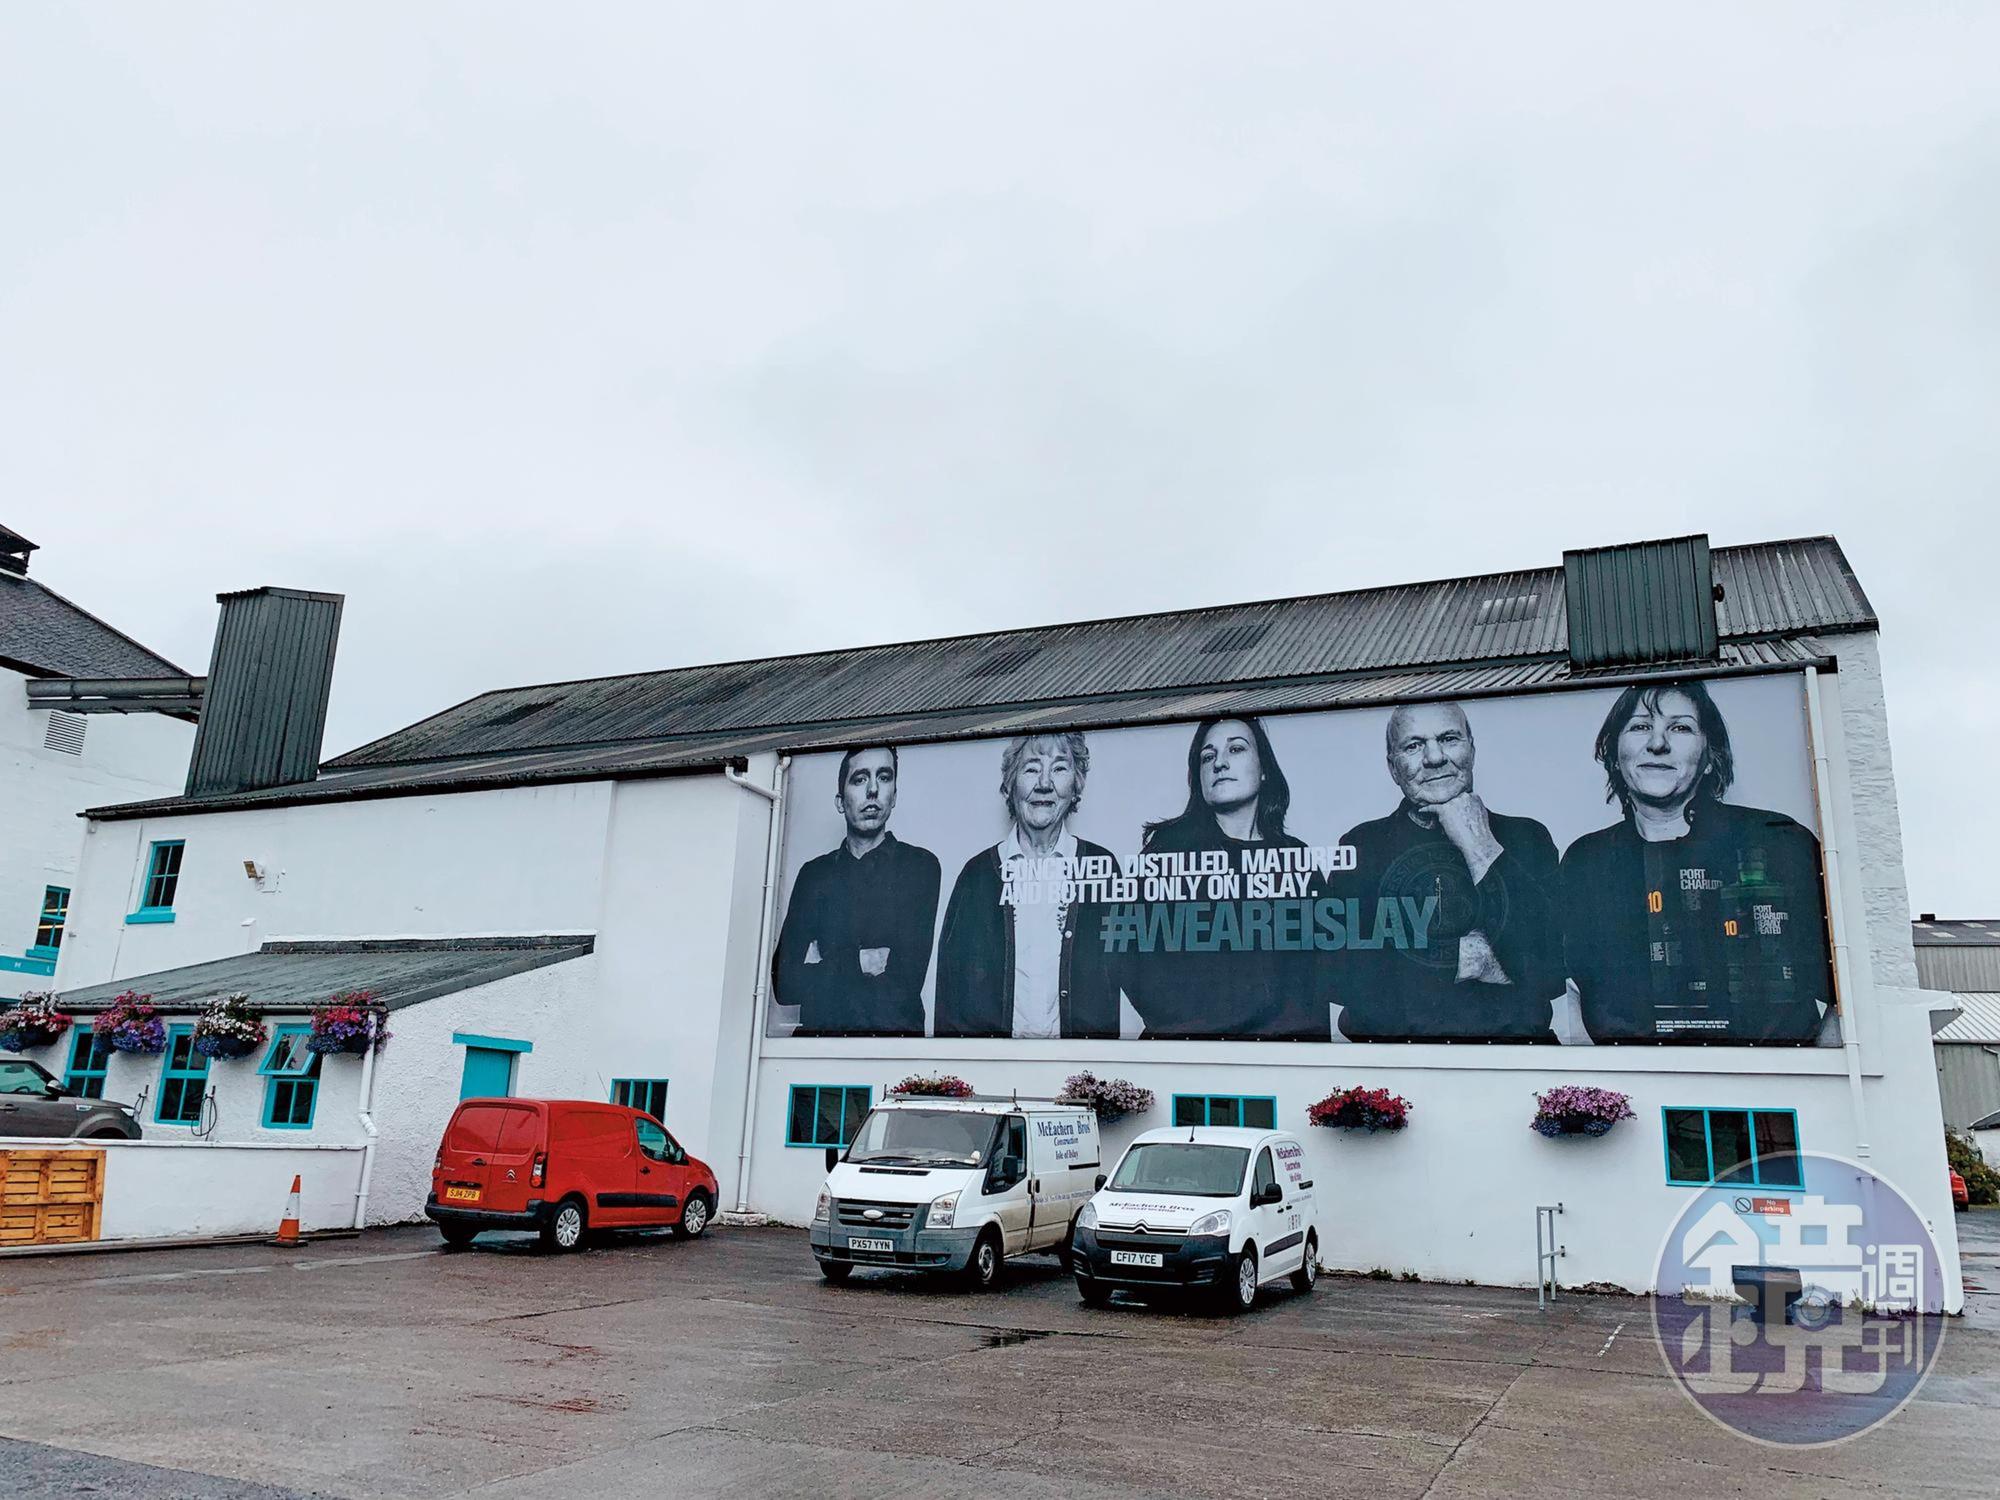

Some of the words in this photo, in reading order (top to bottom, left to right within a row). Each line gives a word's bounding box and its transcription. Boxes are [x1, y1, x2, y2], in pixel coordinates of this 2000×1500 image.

[1000, 855, 1118, 882] CONCEIVED,
[1123, 850, 1235, 878] DISTILLED,
[1241, 845, 1358, 874] MATURED
[1680, 868, 1706, 880] PORT
[1045, 877, 1139, 904] BOTTLED
[1143, 875, 1203, 902] ONLY
[1207, 873, 1240, 900] ON
[1246, 872, 1318, 899] ISLAY.
[1647, 891, 1662, 913] 10
[1752, 904, 1772, 913] PORT
[1100, 896, 1438, 953] #WEAREISLAY
[1724, 920, 1738, 936] 10
[1037, 1121, 1074, 1137] McEachern
[1766, 1199, 1777, 1207] No
[851, 1239, 873, 1249] PX57
[873, 1240, 891, 1250] YYN
[1116, 1252, 1138, 1264] CF17
[1138, 1253, 1157, 1265] YCE
